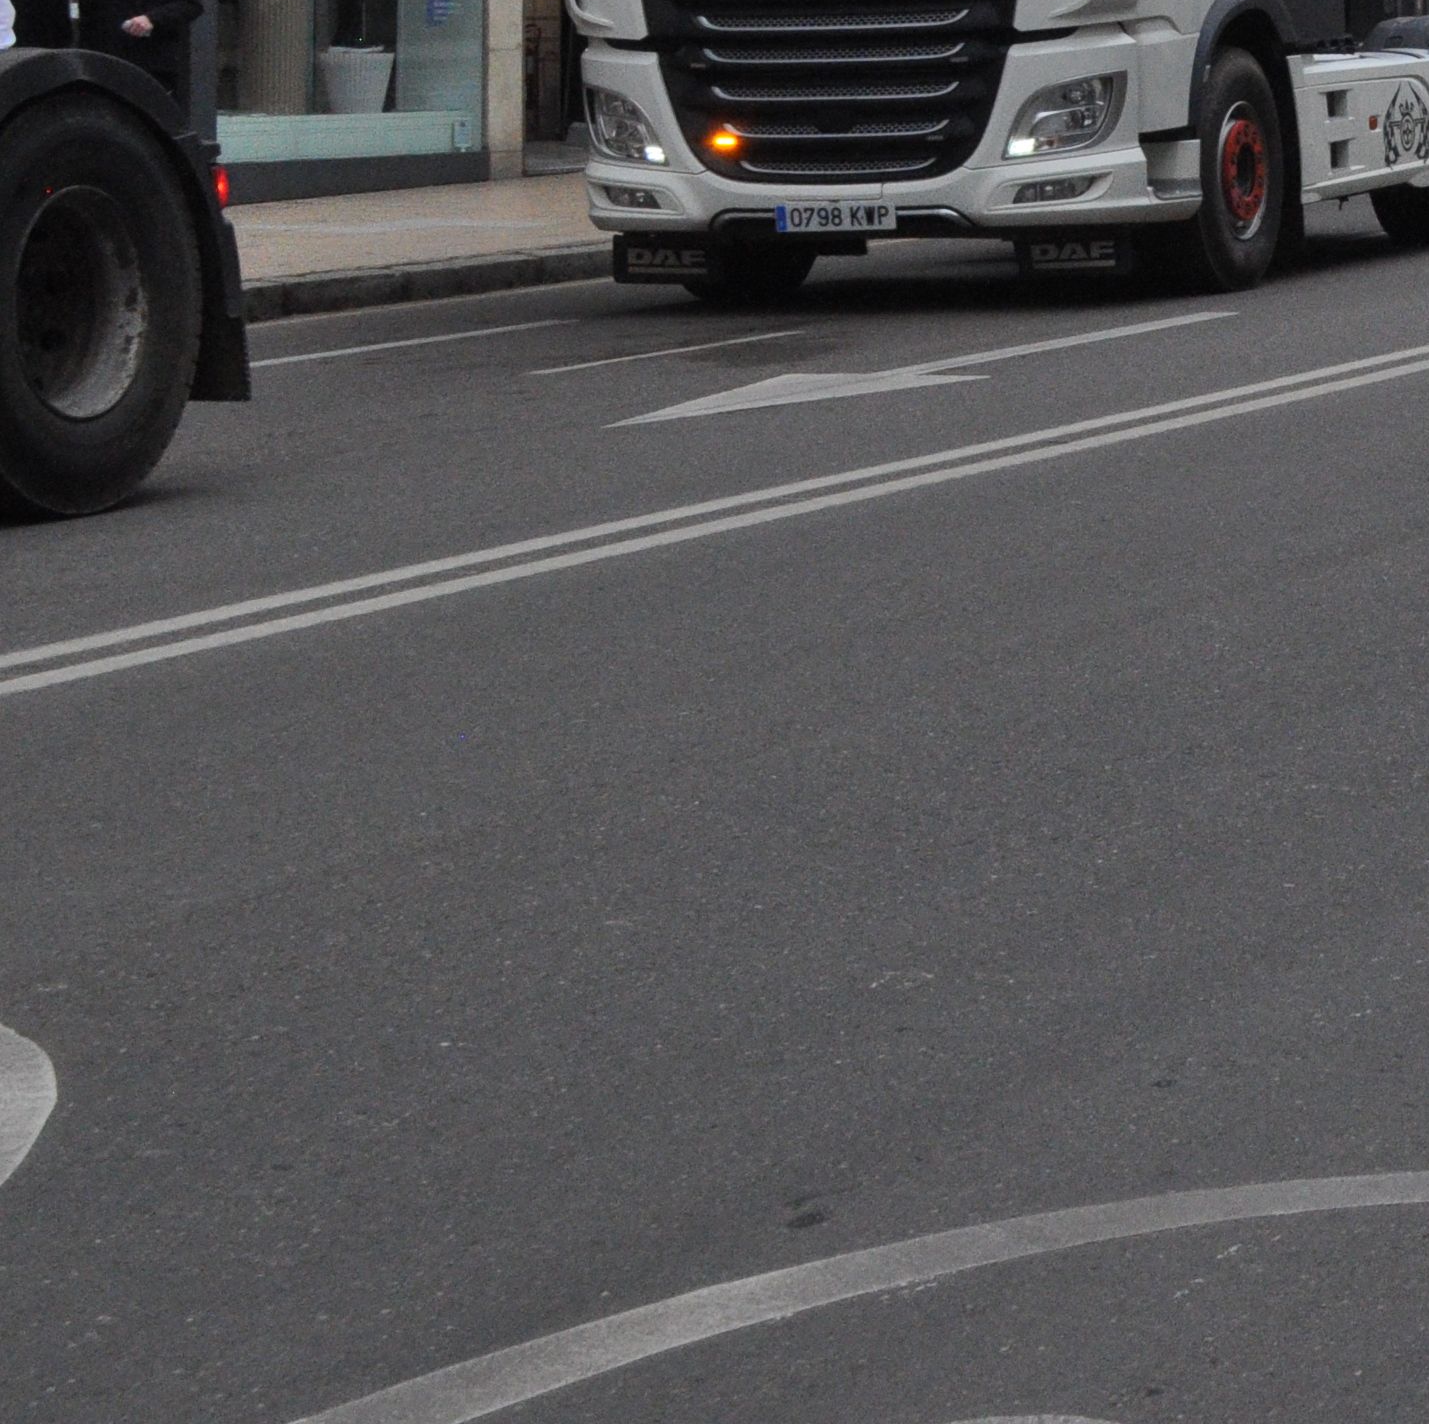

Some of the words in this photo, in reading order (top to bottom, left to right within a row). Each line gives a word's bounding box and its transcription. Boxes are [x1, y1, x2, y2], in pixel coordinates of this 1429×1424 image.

[790, 207, 843, 228] 0798
[849, 206, 890, 227] KWP
[627, 247, 706, 267] DAF
[1030, 240, 1116, 261] DAF
